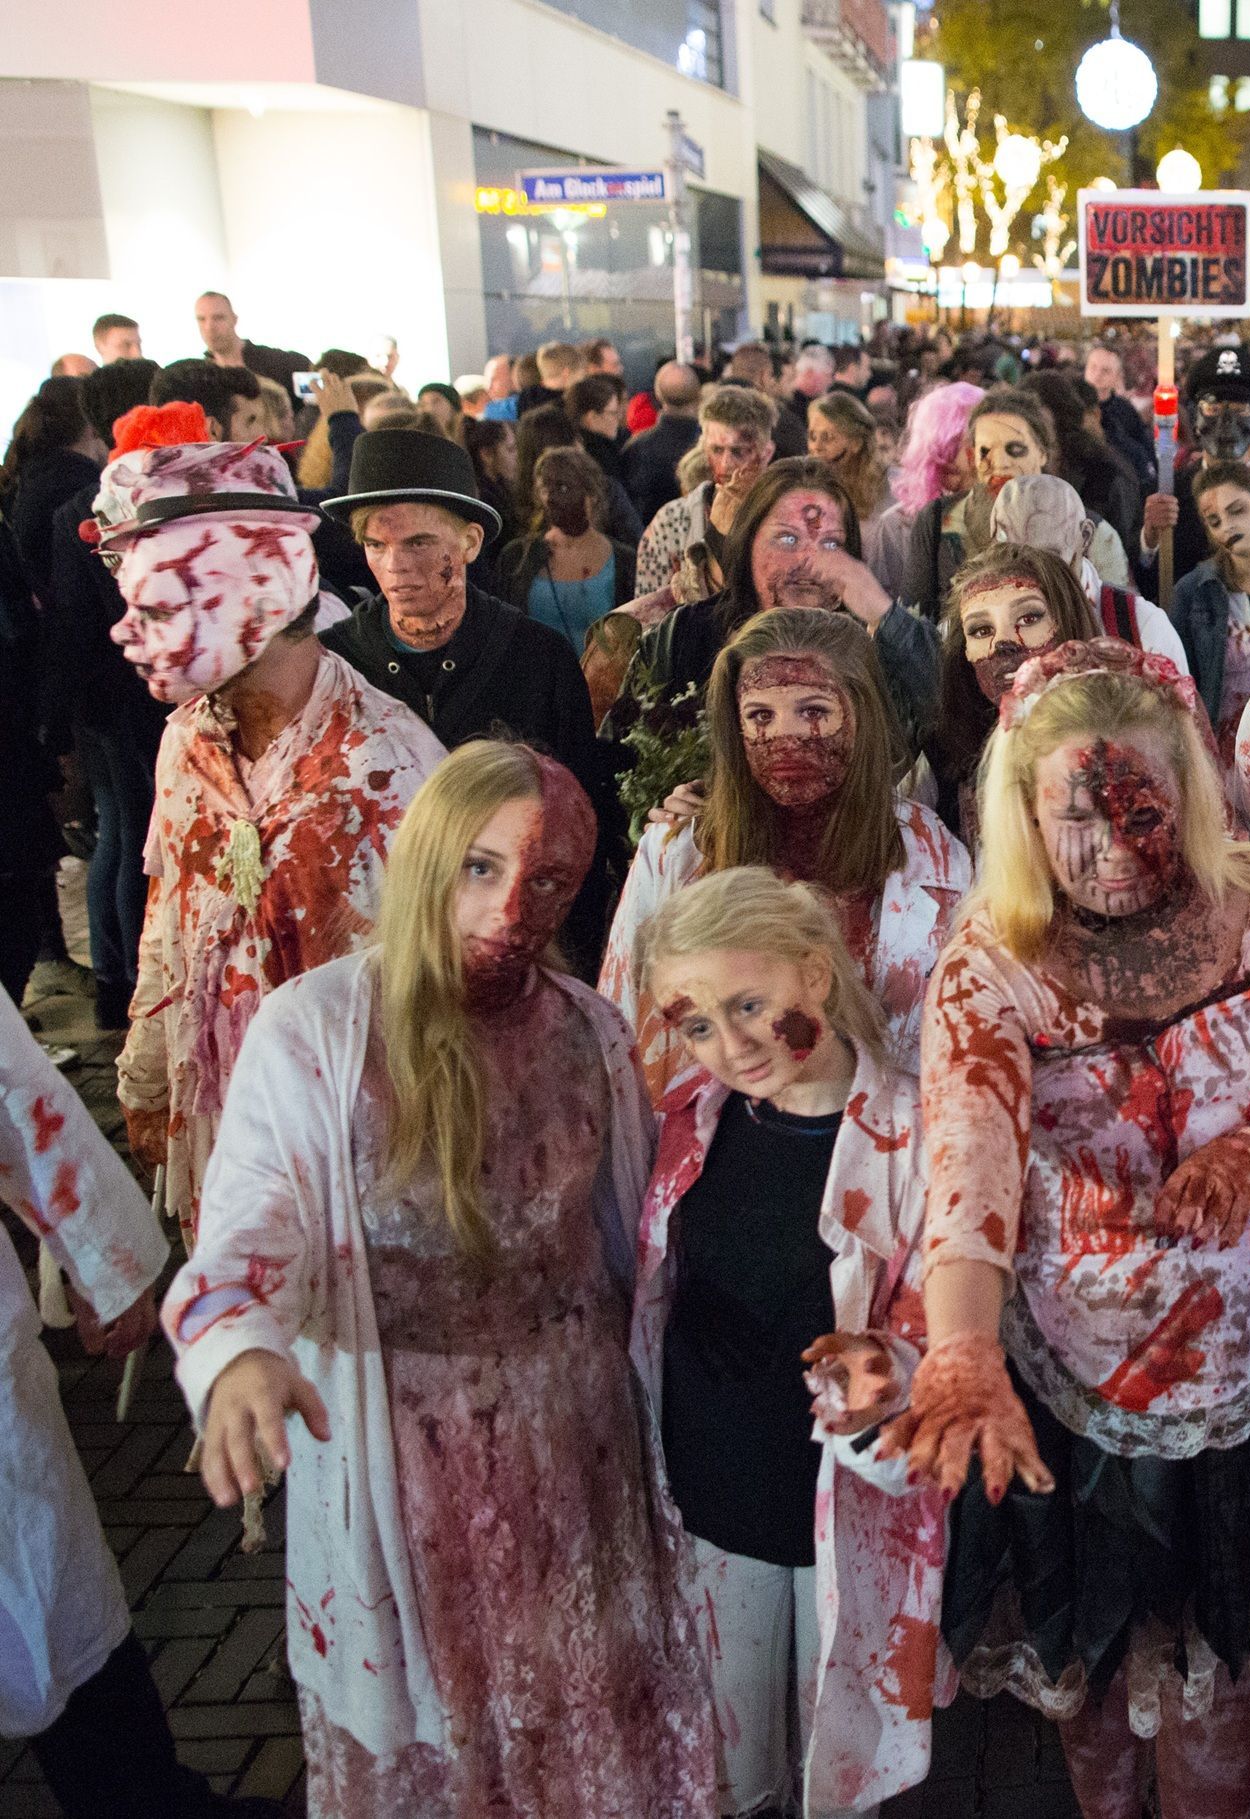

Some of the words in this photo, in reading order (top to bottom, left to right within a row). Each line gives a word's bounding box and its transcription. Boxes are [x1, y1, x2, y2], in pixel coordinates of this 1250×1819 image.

[534, 179, 563, 199] Am
[564, 174, 662, 201] Glockspiel
[1092, 210, 1242, 246] VORSICHT!
[1090, 255, 1242, 300] ZOMBIES
